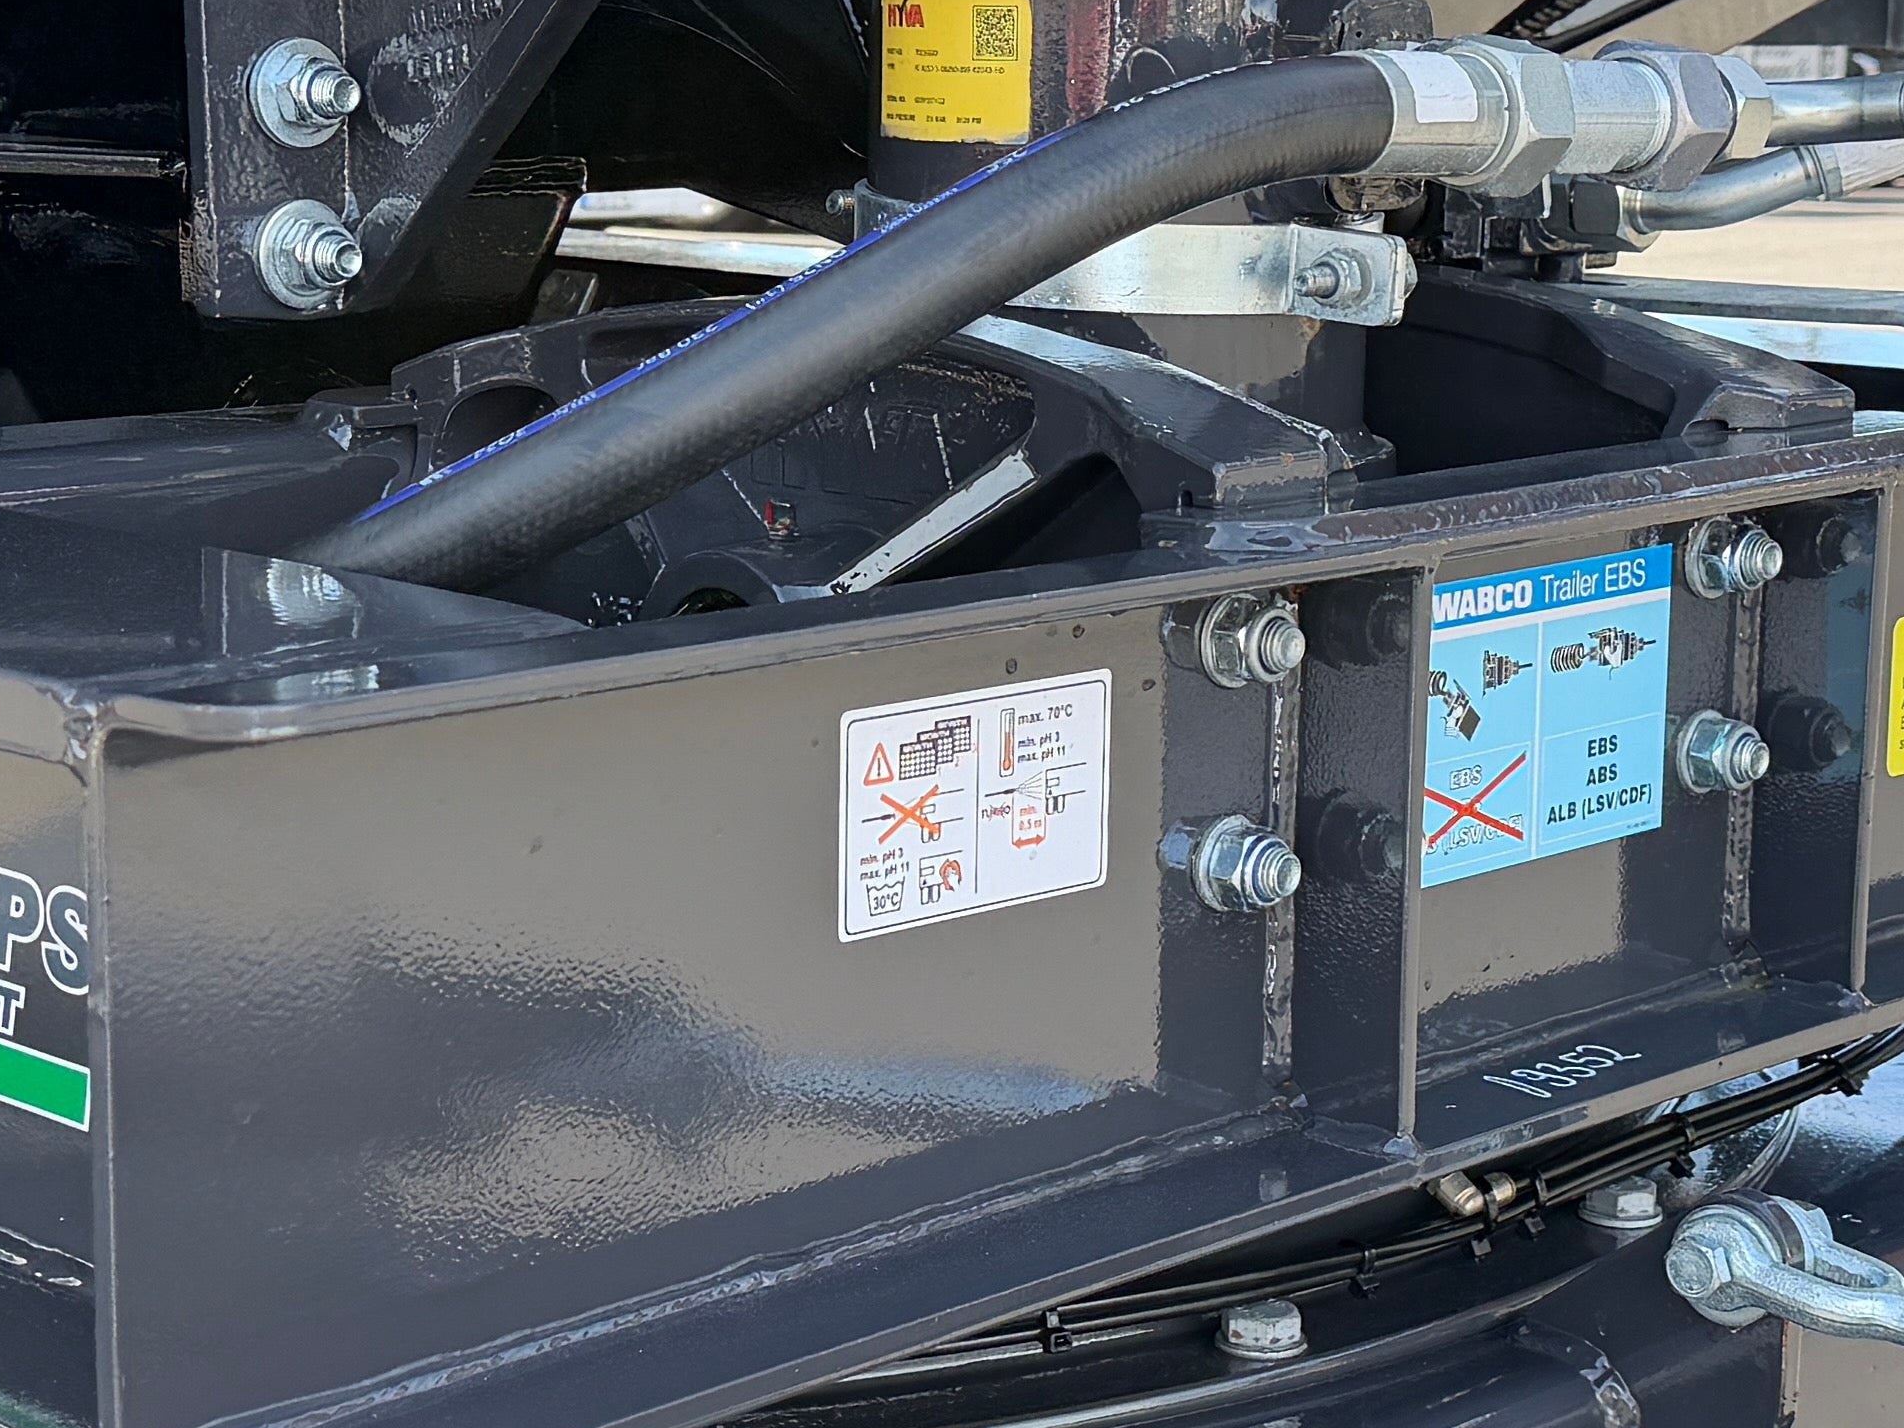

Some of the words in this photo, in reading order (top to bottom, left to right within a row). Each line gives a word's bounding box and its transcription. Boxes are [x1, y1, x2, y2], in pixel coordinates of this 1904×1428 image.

[1432, 579, 1532, 623] WABCO
[1540, 570, 1599, 604] Trailer
[1605, 559, 1646, 593] EBS
[1018, 712, 1044, 726] max.
[1047, 704, 1073, 721] 70°C
[1040, 735, 1052, 747] pH
[1587, 735, 1618, 758] EBS
[1018, 751, 1038, 764] max.
[1041, 748, 1054, 761] pH
[1056, 746, 1066, 757] 11
[1586, 763, 1618, 787] ABS
[1547, 800, 1577, 825] ALB
[1582, 784, 1652, 821] (LSV/CDF)
[882, 850, 896, 864] pH
[860, 868, 881, 880] max.
[884, 864, 898, 879] pH
[900, 862, 910, 874] 11
[873, 893, 899, 910] 30°C
